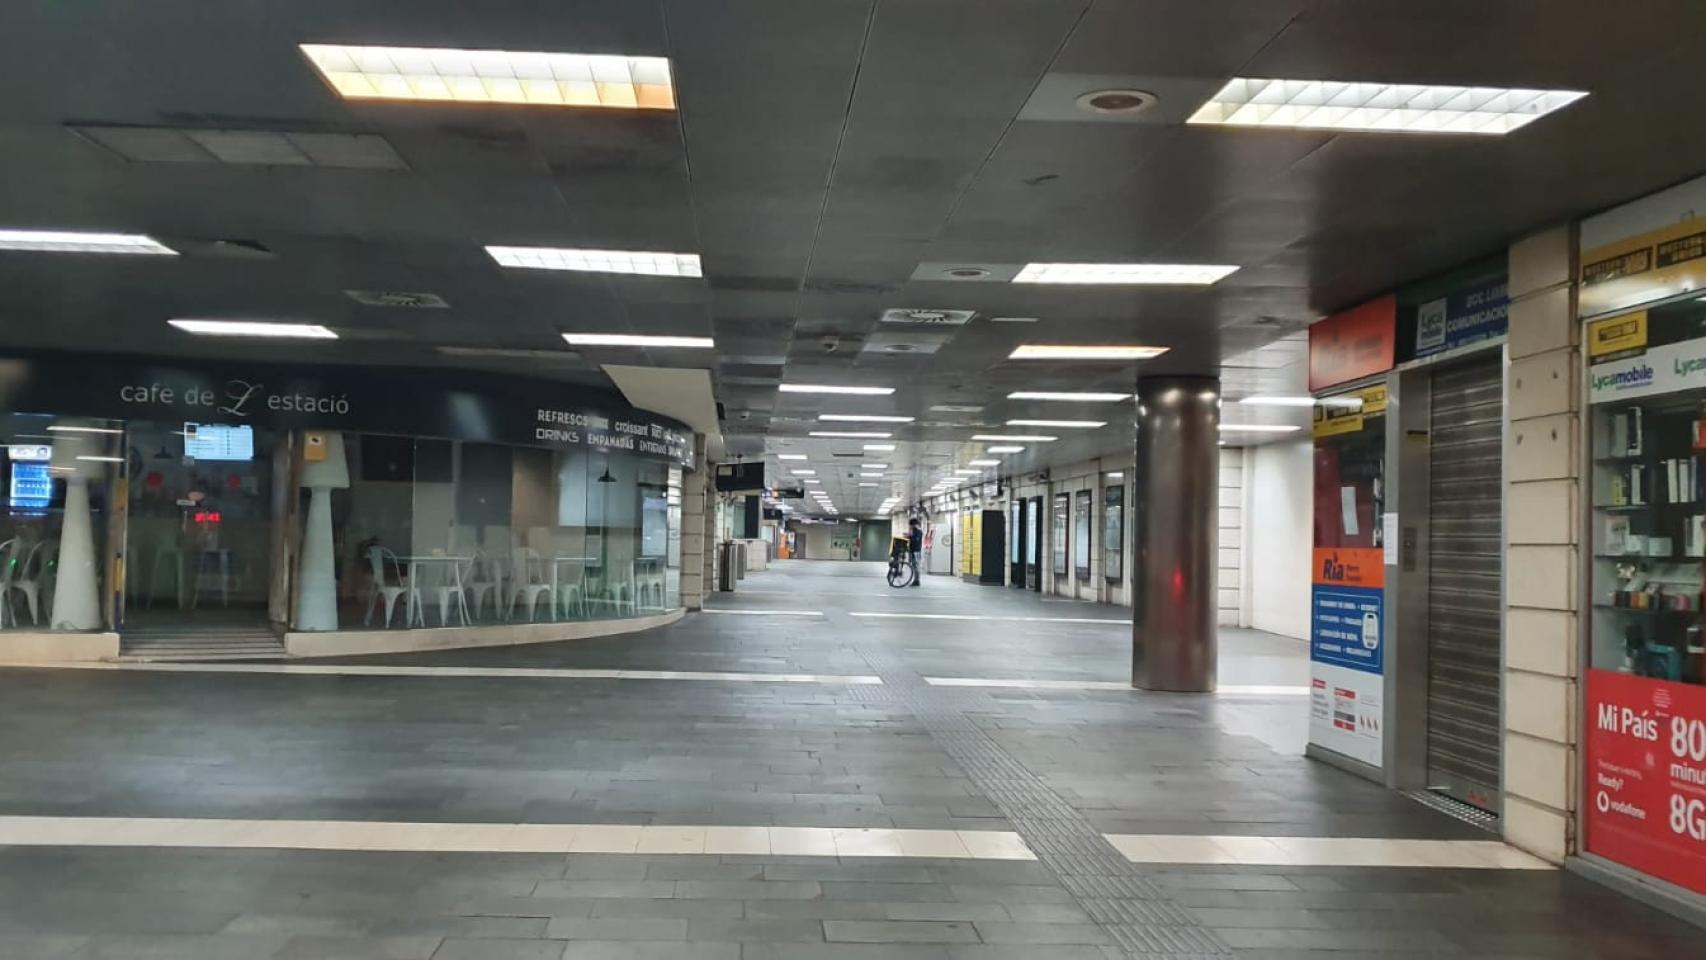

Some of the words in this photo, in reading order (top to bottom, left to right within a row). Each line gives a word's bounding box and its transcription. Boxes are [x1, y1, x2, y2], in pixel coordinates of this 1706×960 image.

[1447, 305, 1507, 332] COMUNICACIO
[1591, 364, 1654, 391] Lycamobile
[1674, 357, 1706, 377] Lyca
[120, 382, 174, 404] cafe
[184, 383, 214, 406] de
[267, 393, 350, 416] estació
[536, 428, 580, 443] DRINKS
[587, 433, 634, 450] EMPANADAS
[1323, 556, 1344, 580] Ria
[1597, 702, 1618, 733] Mi
[1621, 708, 1659, 742] País
[1610, 800, 1647, 820] vodafone
[1670, 793, 1706, 842] 8G
